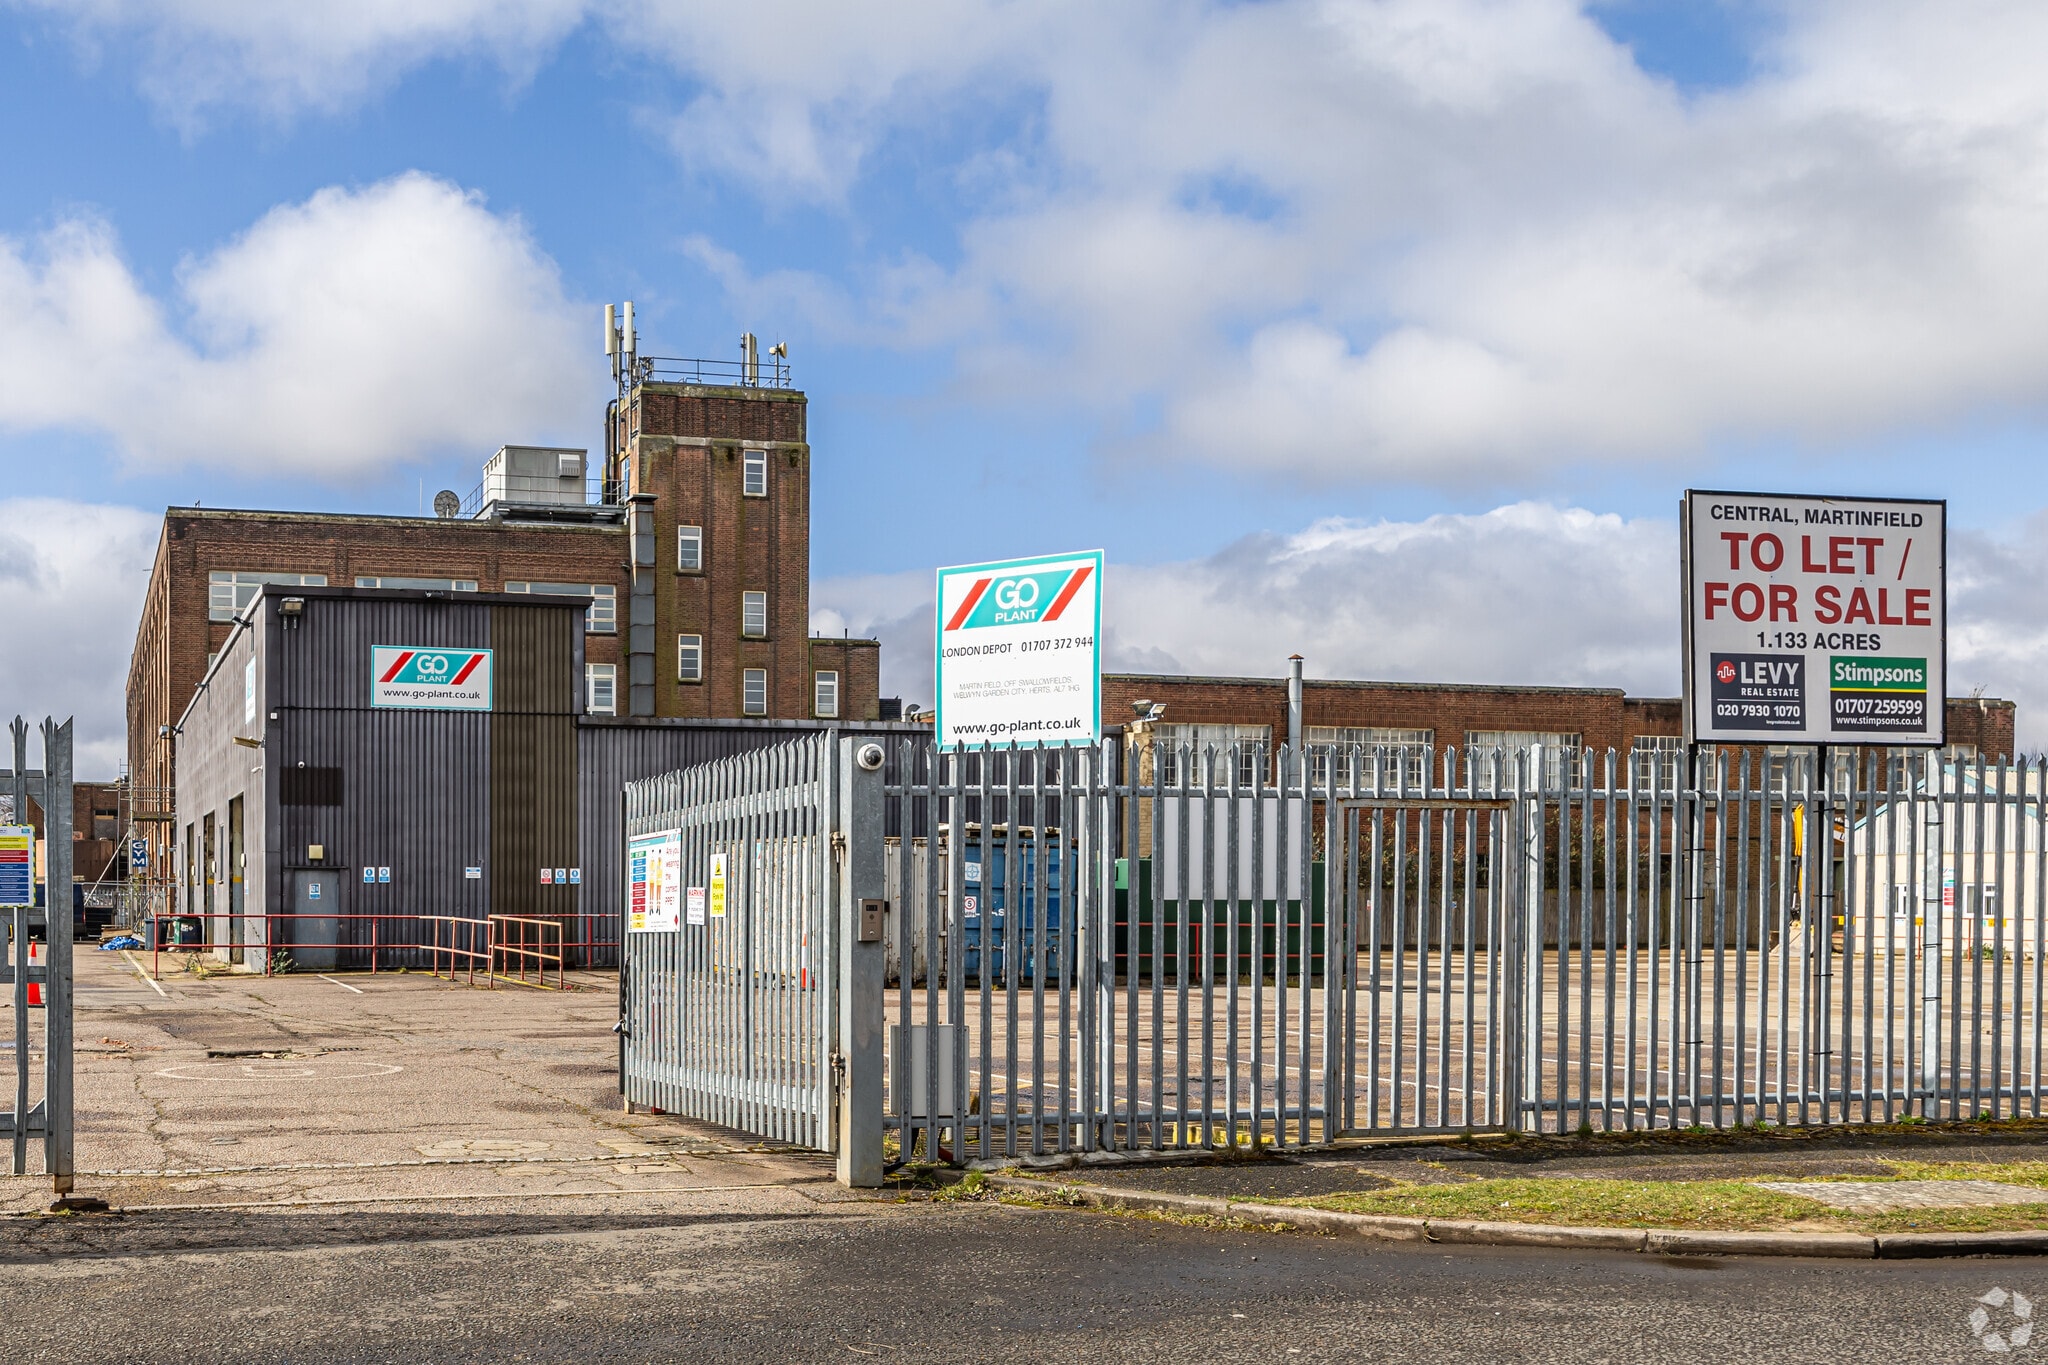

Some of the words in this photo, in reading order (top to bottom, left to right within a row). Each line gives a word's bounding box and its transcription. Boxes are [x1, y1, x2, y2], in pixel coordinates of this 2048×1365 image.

[1710, 504, 1799, 526] CENTRAL,
[1804, 508, 1923, 528] MARTINFIELD
[1720, 531, 1784, 573] TO
[1801, 534, 1884, 575] LET
[1897, 538, 1913, 581] /
[995, 577, 1039, 610] GO
[1704, 581, 1798, 623] FOR
[1814, 584, 1932, 626] SALE
[995, 608, 1039, 623] PLANT
[942, 645, 981, 658] LONDON
[982, 643, 1013, 655] DEPOT
[1021, 640, 1051, 652] 01707
[1054, 637, 1072, 649] 372
[1075, 636, 1093, 648] 944
[1756, 632, 1807, 649] 1.133
[1813, 633, 1881, 651] ACRES
[416, 654, 449, 675] GO
[1740, 661, 1800, 685] LEVY
[1834, 662, 1923, 687] Stimpsons
[416, 674, 448, 683] PLANT
[383, 689, 481, 700] www.go-plant.co.uk
[982, 689, 1010, 698] GARDEN
[1741, 687, 1764, 697] REAL
[1767, 688, 1800, 698] ESTATE
[1717, 704, 1739, 717] 020
[1741, 704, 1770, 717] 7930
[1773, 705, 1800, 718] 1070
[1836, 715, 1923, 727] www.stimpsons.co.uk
[953, 717, 1081, 736] www.go-plant.co.uk
[132, 841, 145, 865] GYM
